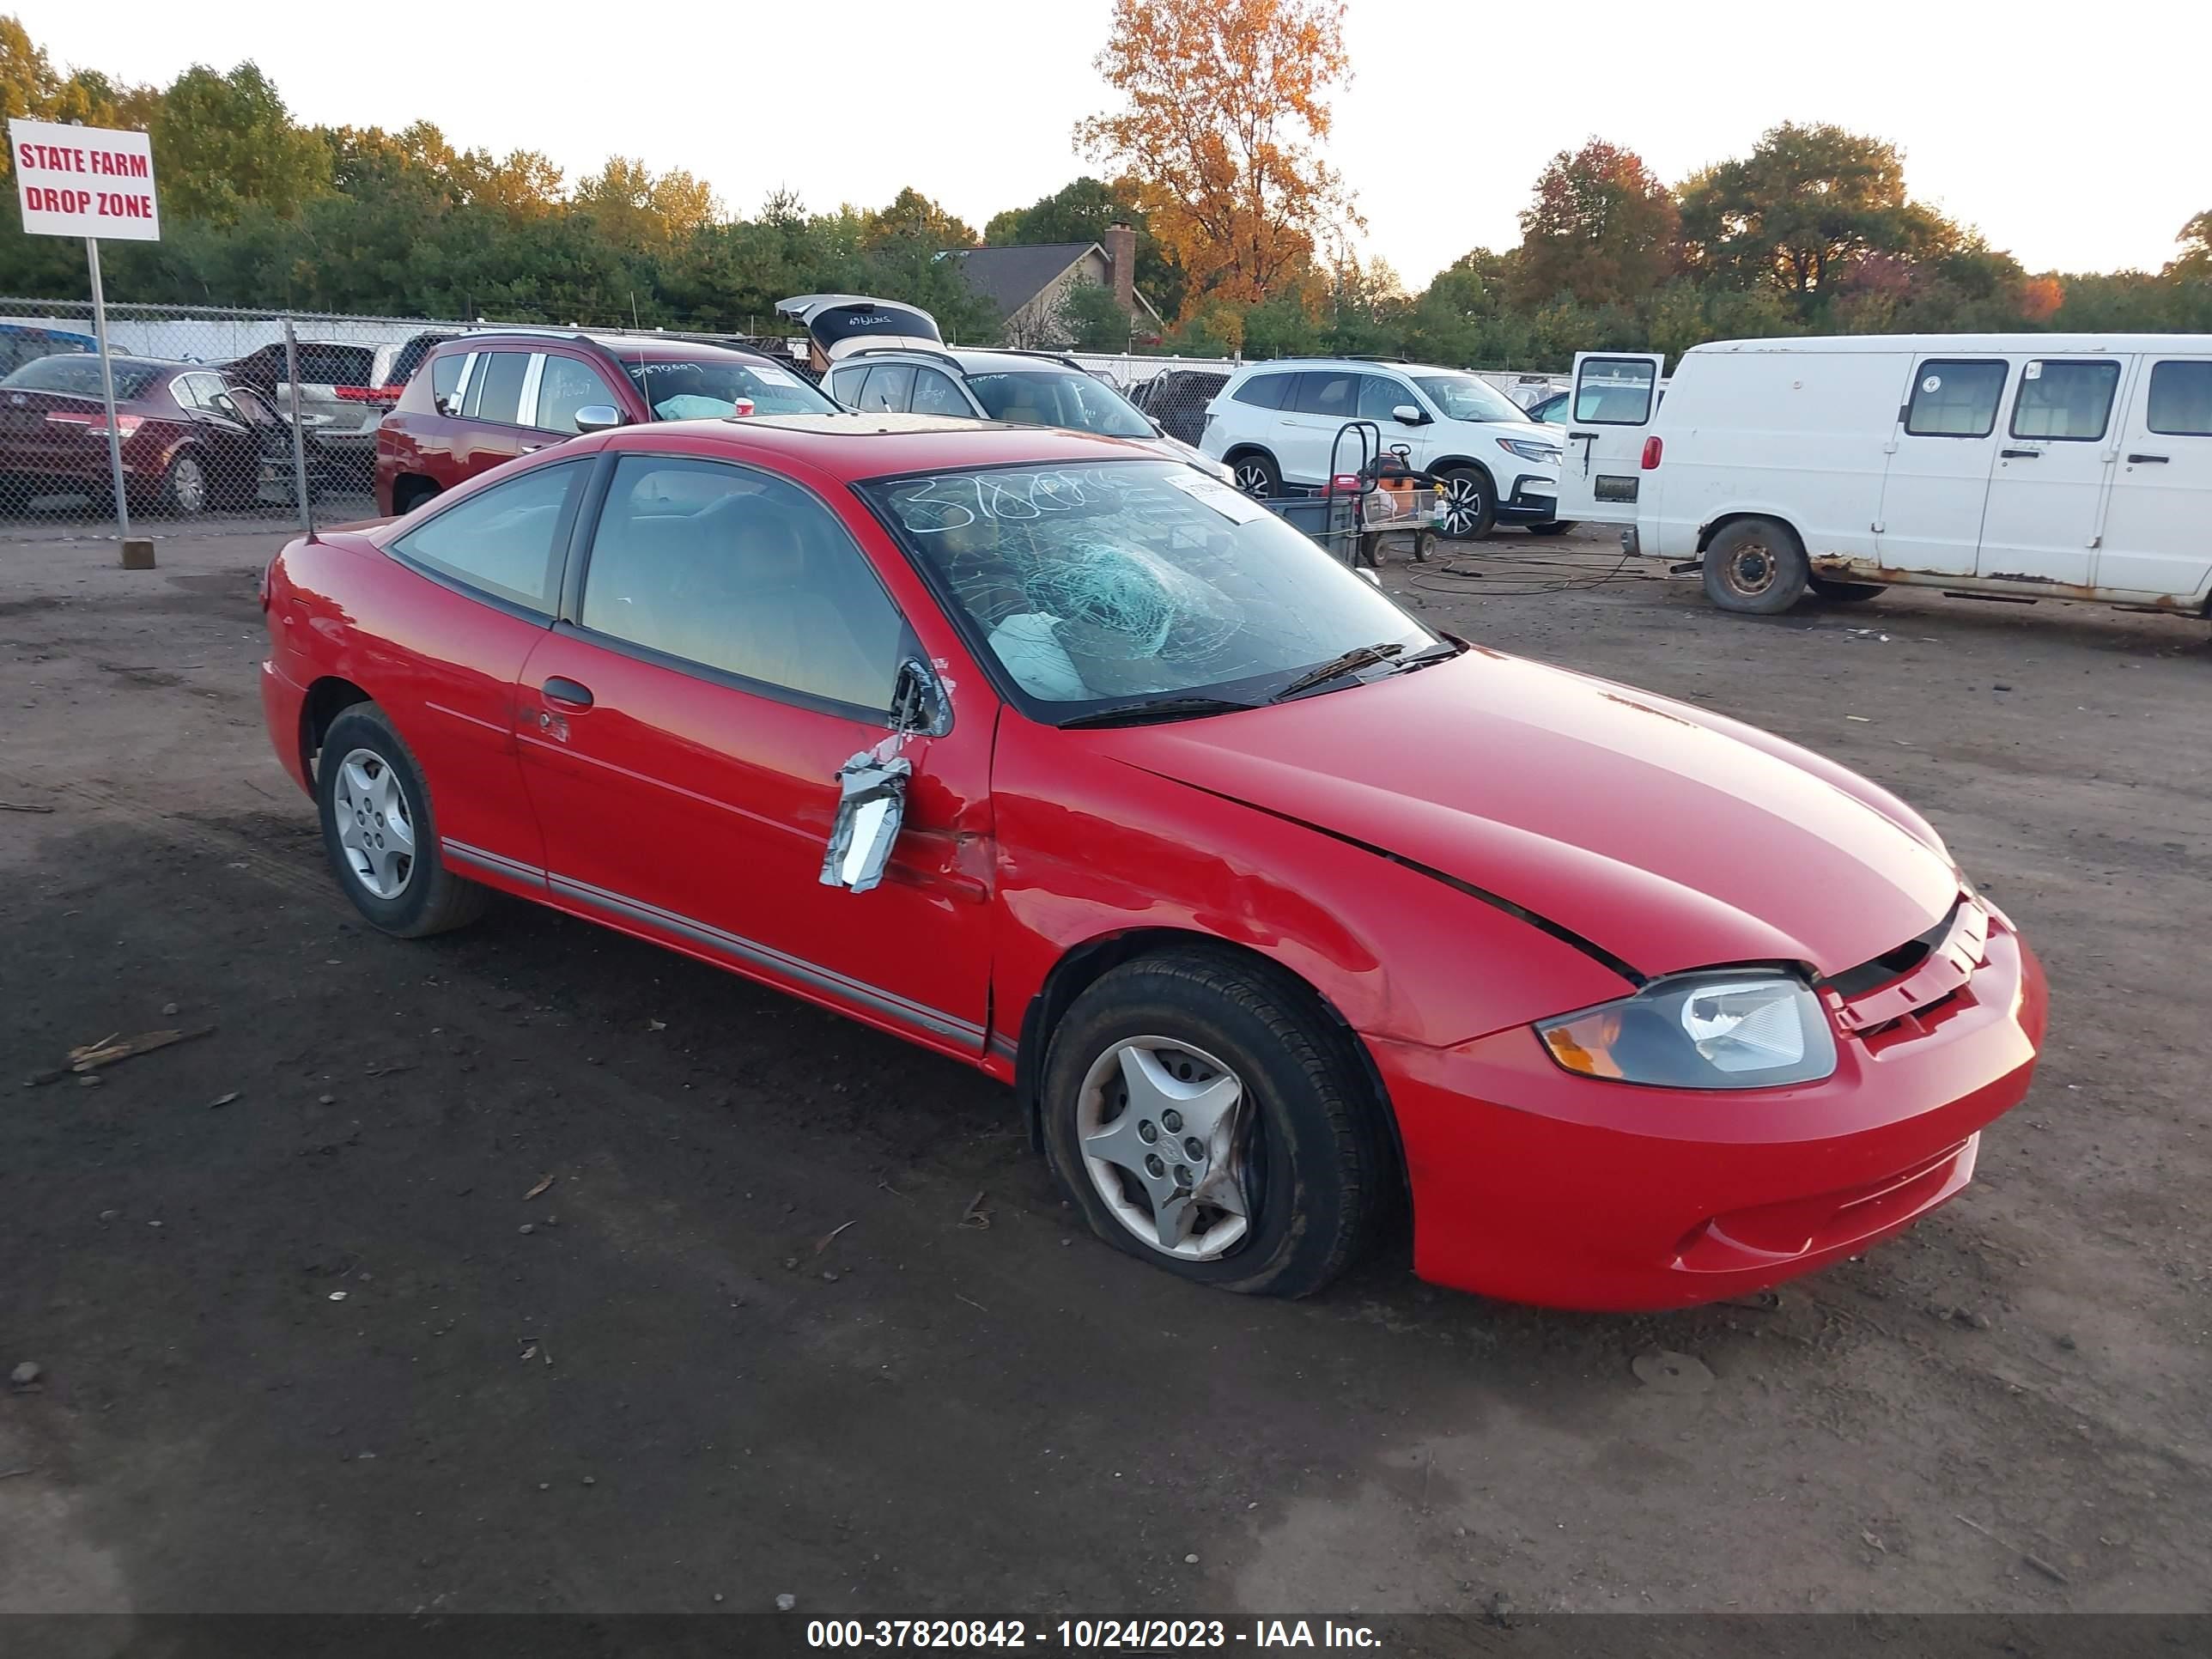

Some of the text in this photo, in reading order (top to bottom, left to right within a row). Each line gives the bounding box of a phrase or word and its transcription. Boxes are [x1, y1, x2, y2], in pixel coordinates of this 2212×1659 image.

[20, 143, 148, 178] STATE FARM
[26, 186, 152, 218] DROP ZONE
